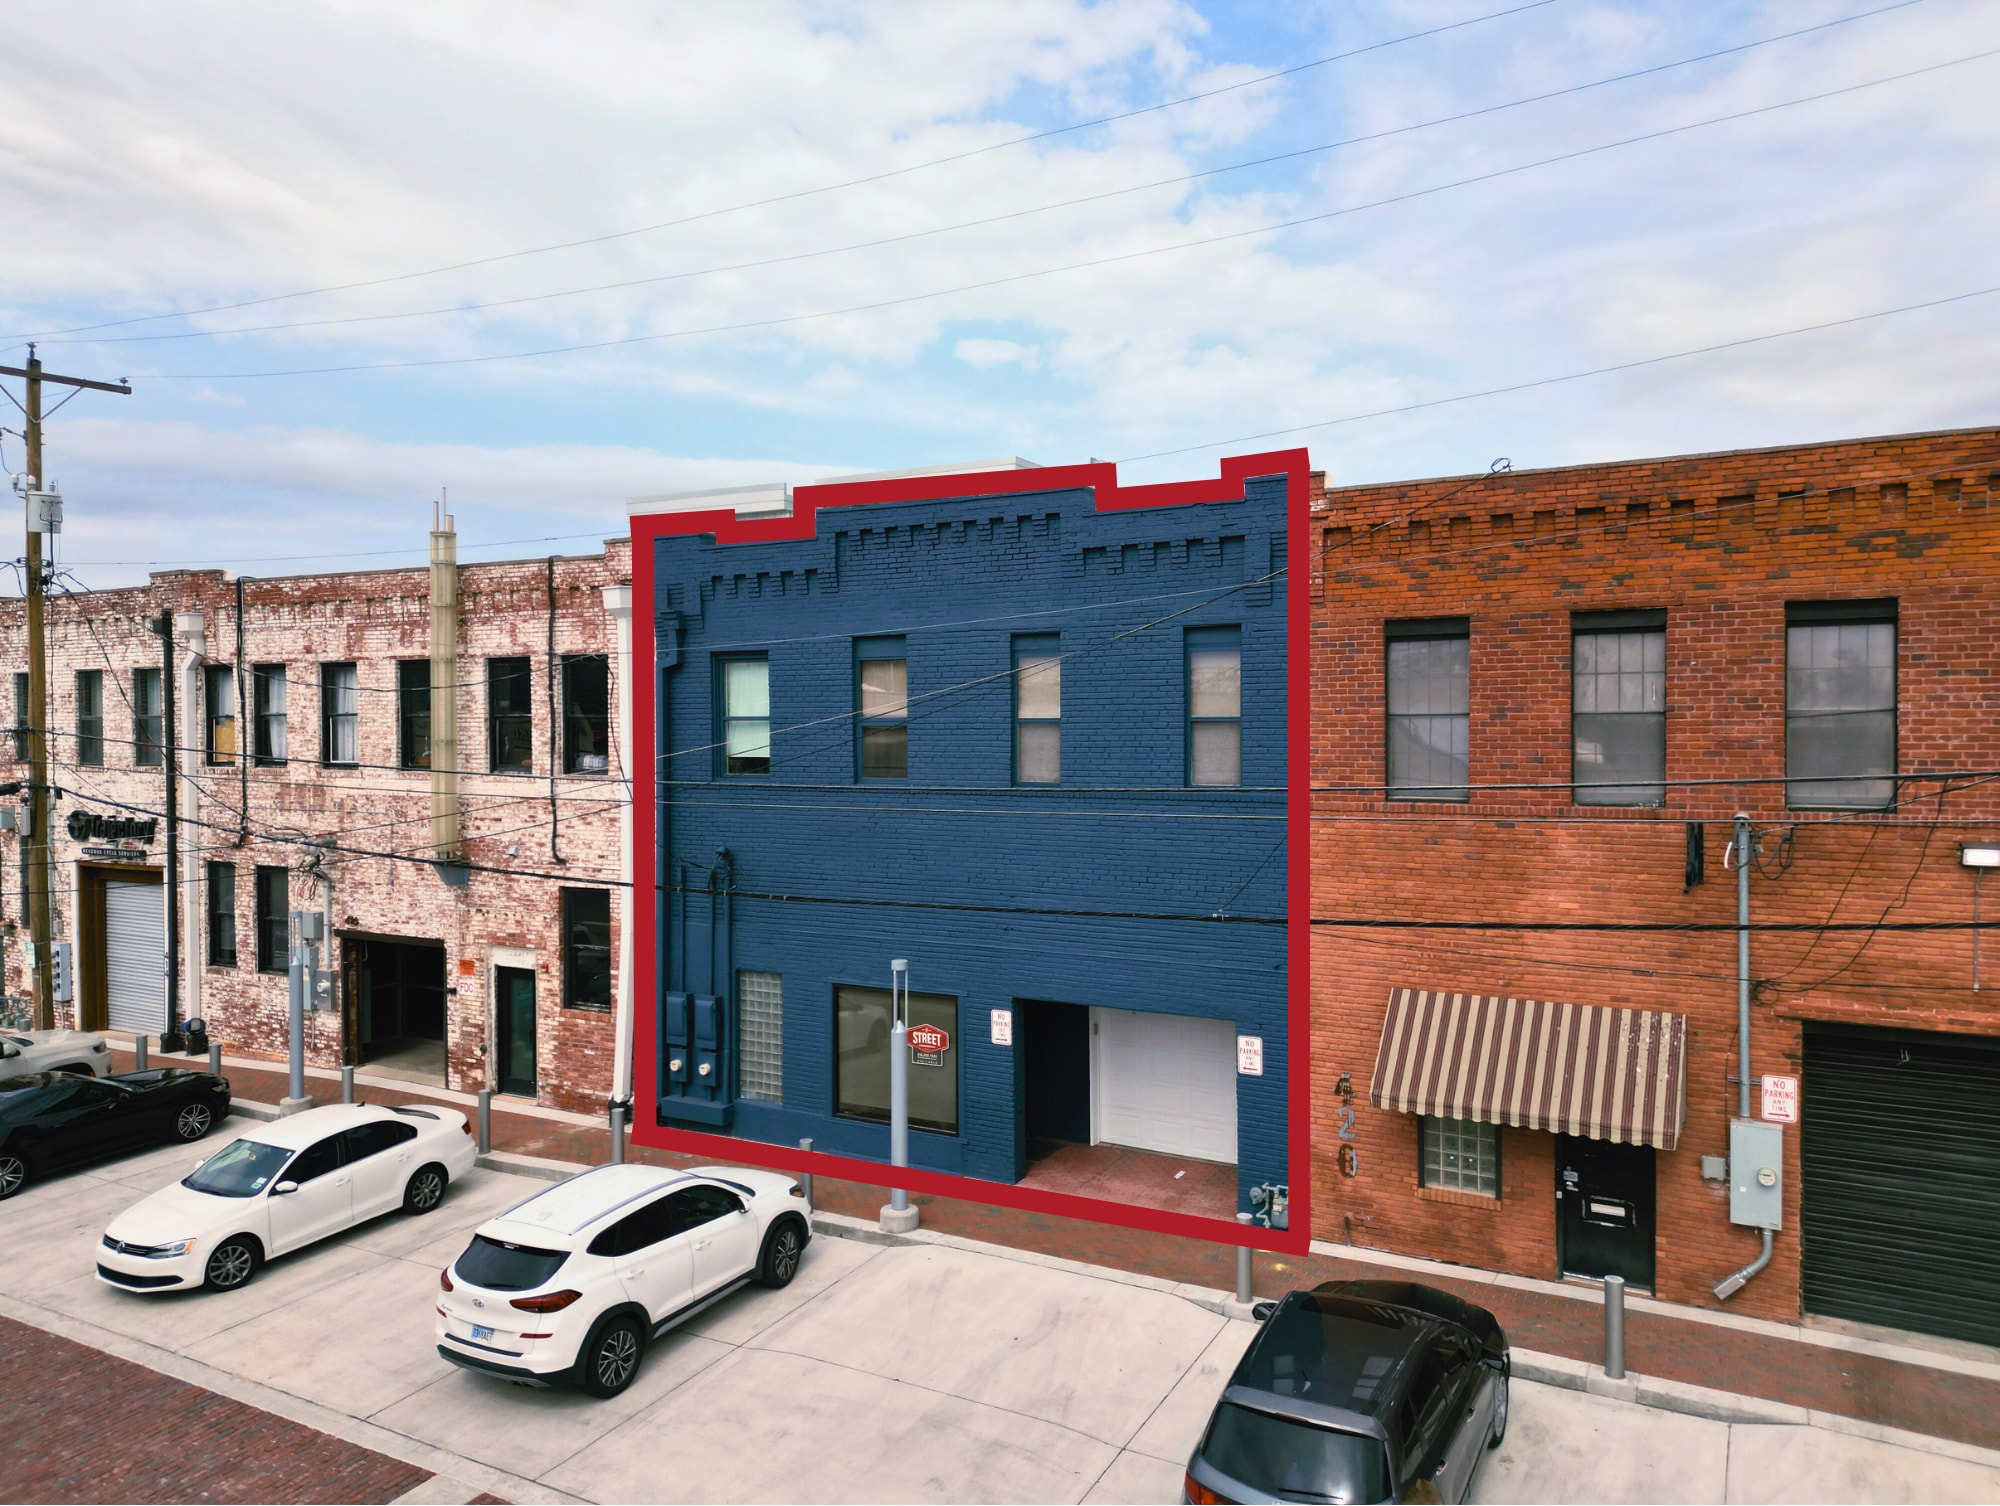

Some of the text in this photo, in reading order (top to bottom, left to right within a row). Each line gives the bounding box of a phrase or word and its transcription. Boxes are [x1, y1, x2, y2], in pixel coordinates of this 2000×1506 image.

[89, 814, 158, 848] Trajectory
[460, 982, 474, 993] FDC
[912, 1031, 942, 1047] STREET
[1245, 1040, 1255, 1048] NO
[1239, 1047, 1261, 1056] PARKING
[1773, 1080, 1786, 1089] NO
[1764, 1089, 1794, 1100] PARKING
